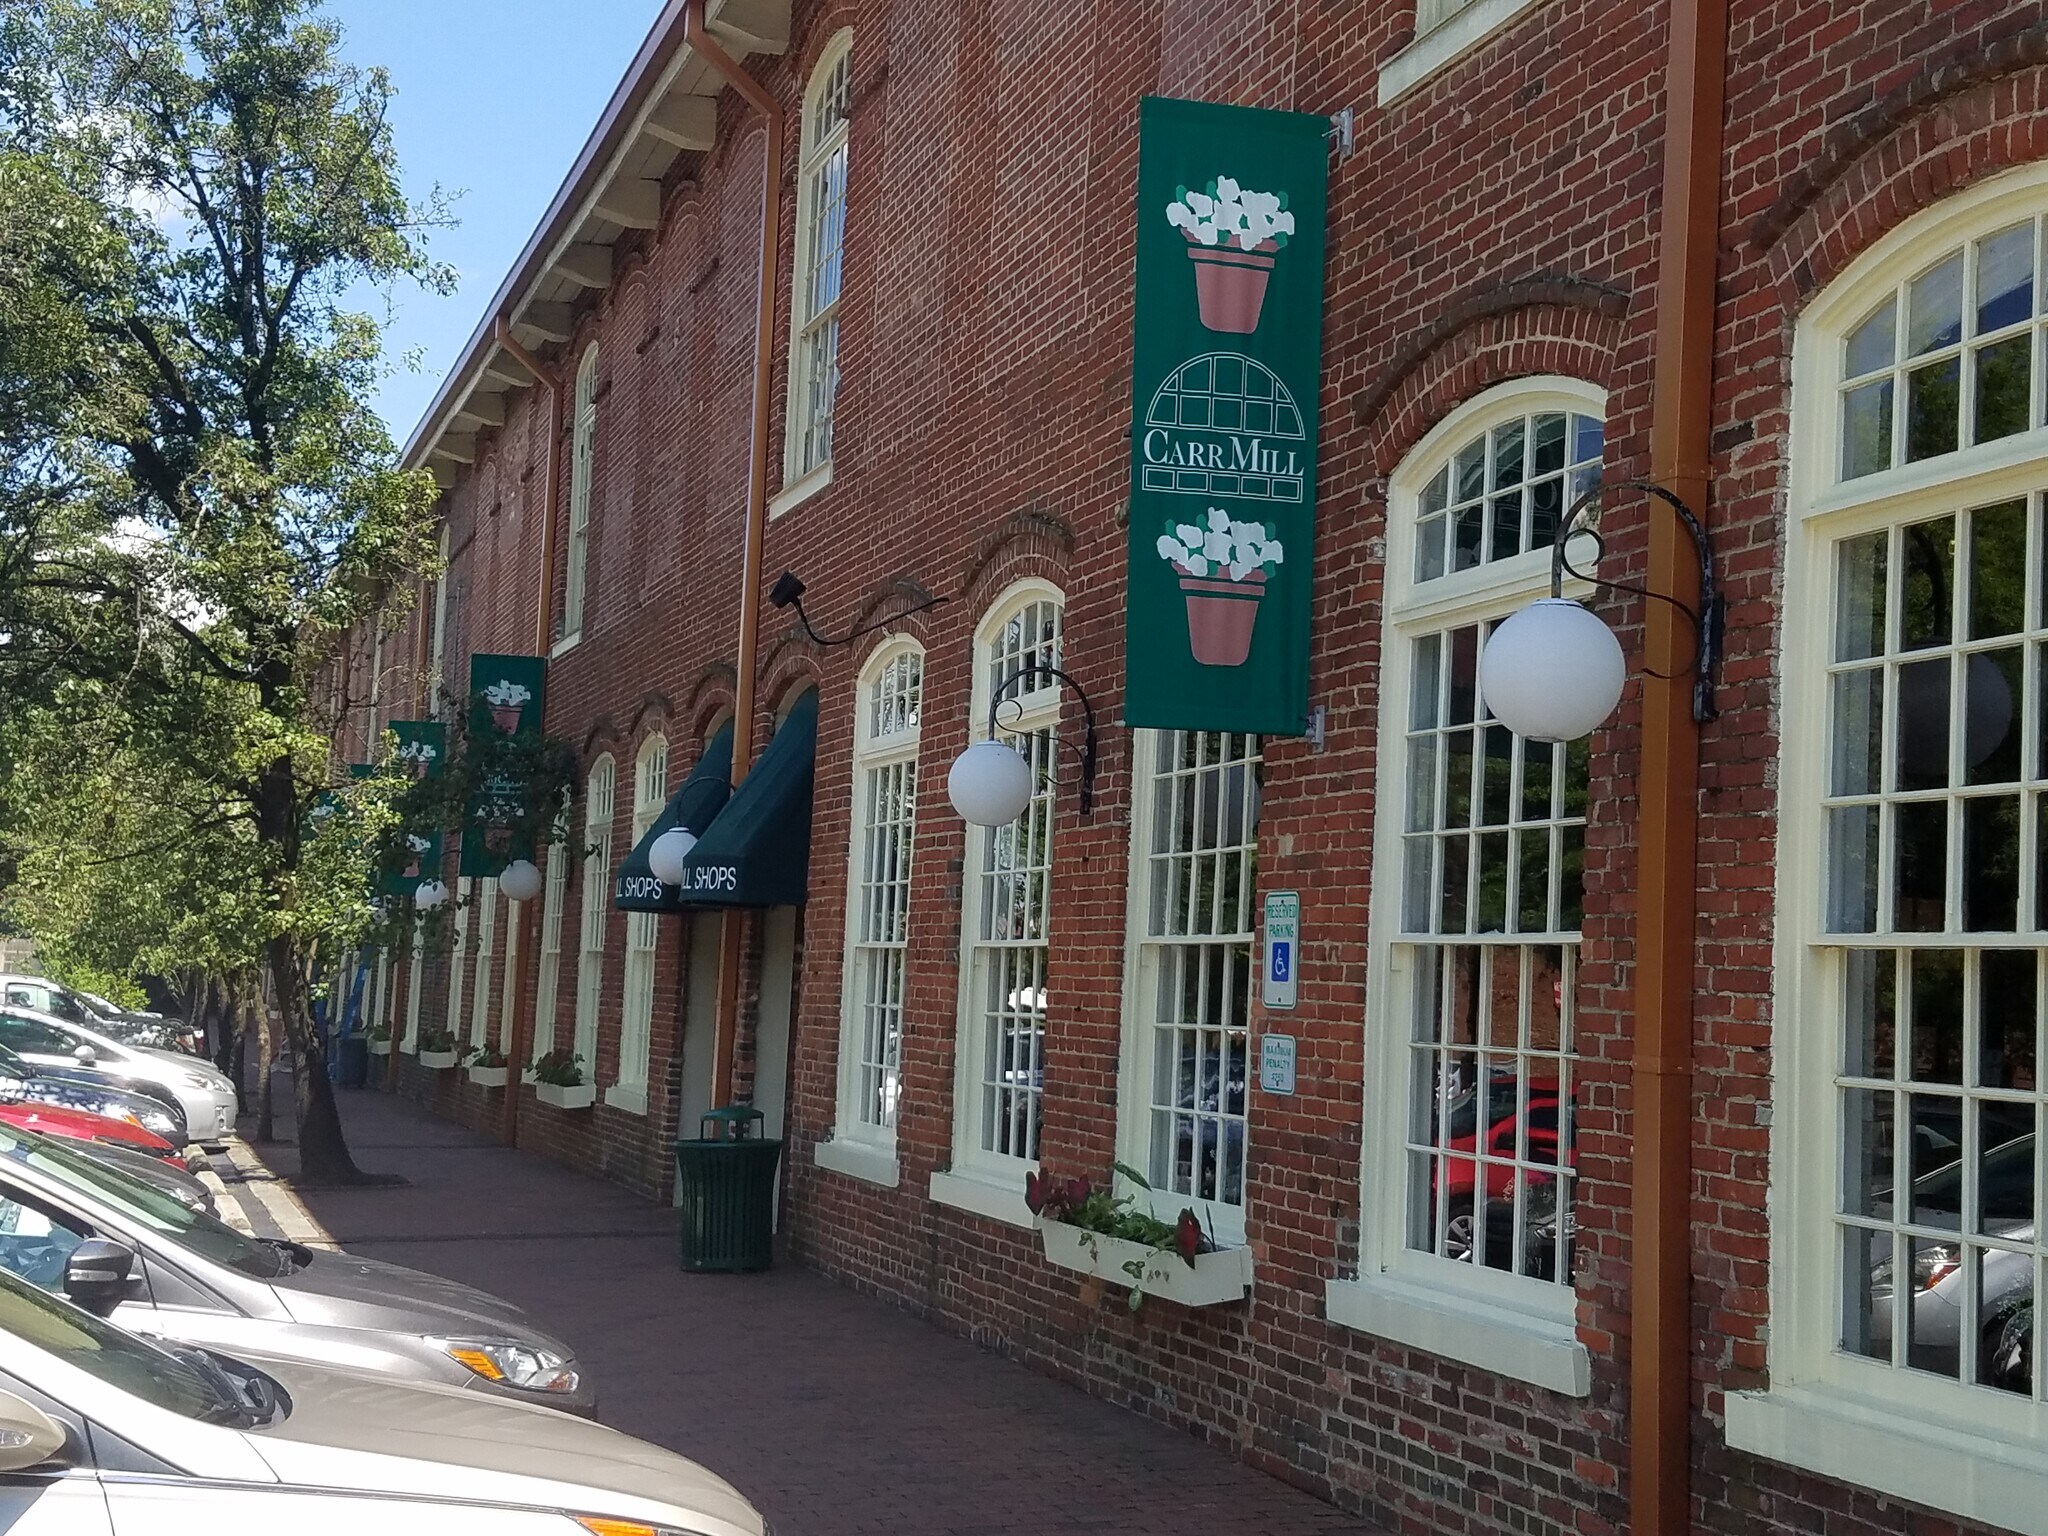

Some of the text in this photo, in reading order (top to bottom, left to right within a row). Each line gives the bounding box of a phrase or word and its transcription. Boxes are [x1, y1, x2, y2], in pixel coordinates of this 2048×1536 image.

[1143, 428, 1305, 477] CARR MILL
[694, 866, 737, 891] SHOPS
[625, 876, 663, 900] SHOPS
[1267, 904, 1297, 919] RESERVED
[1268, 923, 1295, 938] PARKING
[1265, 1045, 1292, 1056] MAXIMUM
[1265, 1058, 1290, 1069] PENALTY
